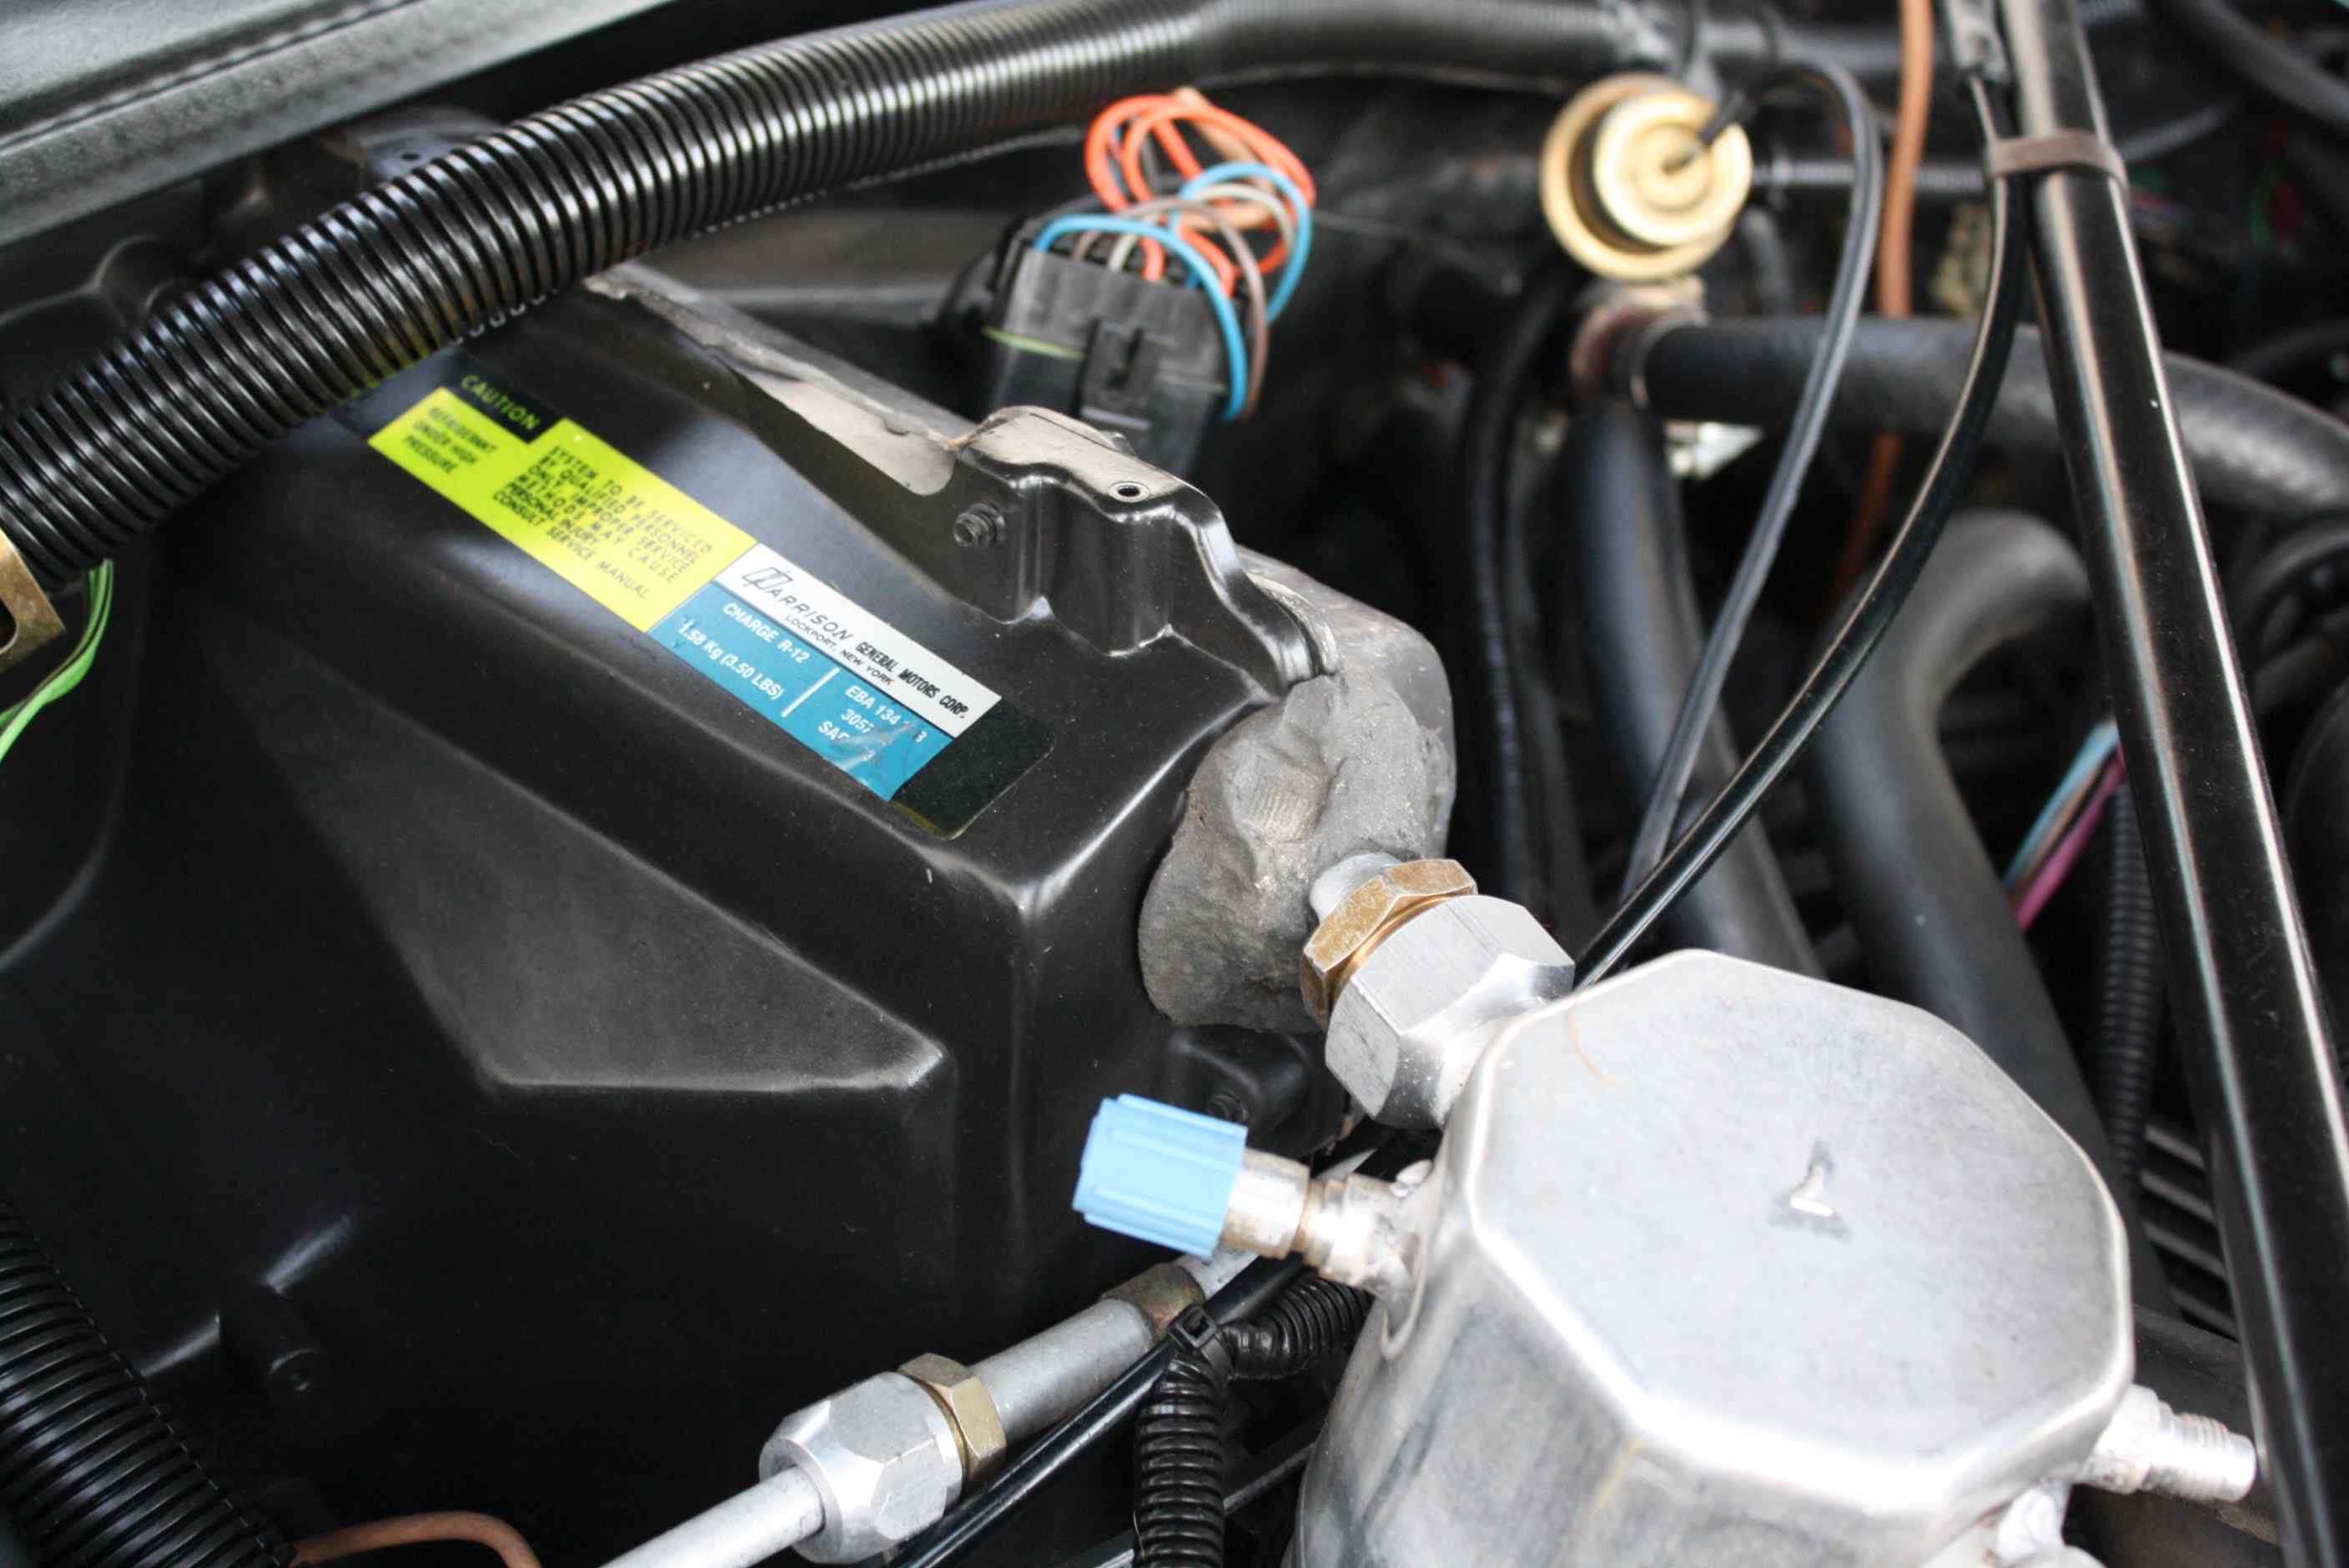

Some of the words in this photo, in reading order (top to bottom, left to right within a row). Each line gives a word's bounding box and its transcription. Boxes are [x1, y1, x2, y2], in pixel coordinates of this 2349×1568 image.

[459, 374, 541, 429] CAUTION
[401, 435, 457, 473] PRESSURE
[492, 490, 545, 526] CONSULT
[546, 526, 595, 560] SERVICE
[504, 481, 559, 519] PERSONAL
[516, 474, 585, 520] METHODS
[589, 522, 622, 545] MAY
[626, 546, 679, 582] CAUSE
[539, 455, 556, 468] BY
[560, 470, 626, 514] QUALIFIED
[629, 515, 701, 562] PERSONNEL
[549, 446, 599, 480] SYSTEM
[601, 480, 623, 495] TO
[626, 495, 644, 509] BE
[646, 510, 713, 554] SERVICED
[570, 493, 632, 535] IMPROPER
[637, 537, 687, 571] SERVICE
[676, 621, 708, 646] 1.58
[700, 640, 727, 660] Kg
[718, 652, 756, 680] (3.50
[748, 673, 786, 701] LBS)
[721, 602, 779, 642] CHARGE
[776, 639, 810, 663] R-12
[784, 614, 839, 651] LOCKPORT,
[840, 650, 863, 666] NEW
[865, 666, 893, 685] YORK
[843, 684, 878, 709] EBA
[855, 641, 899, 672] GENERAL
[898, 668, 940, 698] MOTORS
[938, 695, 971, 718] CORP.
